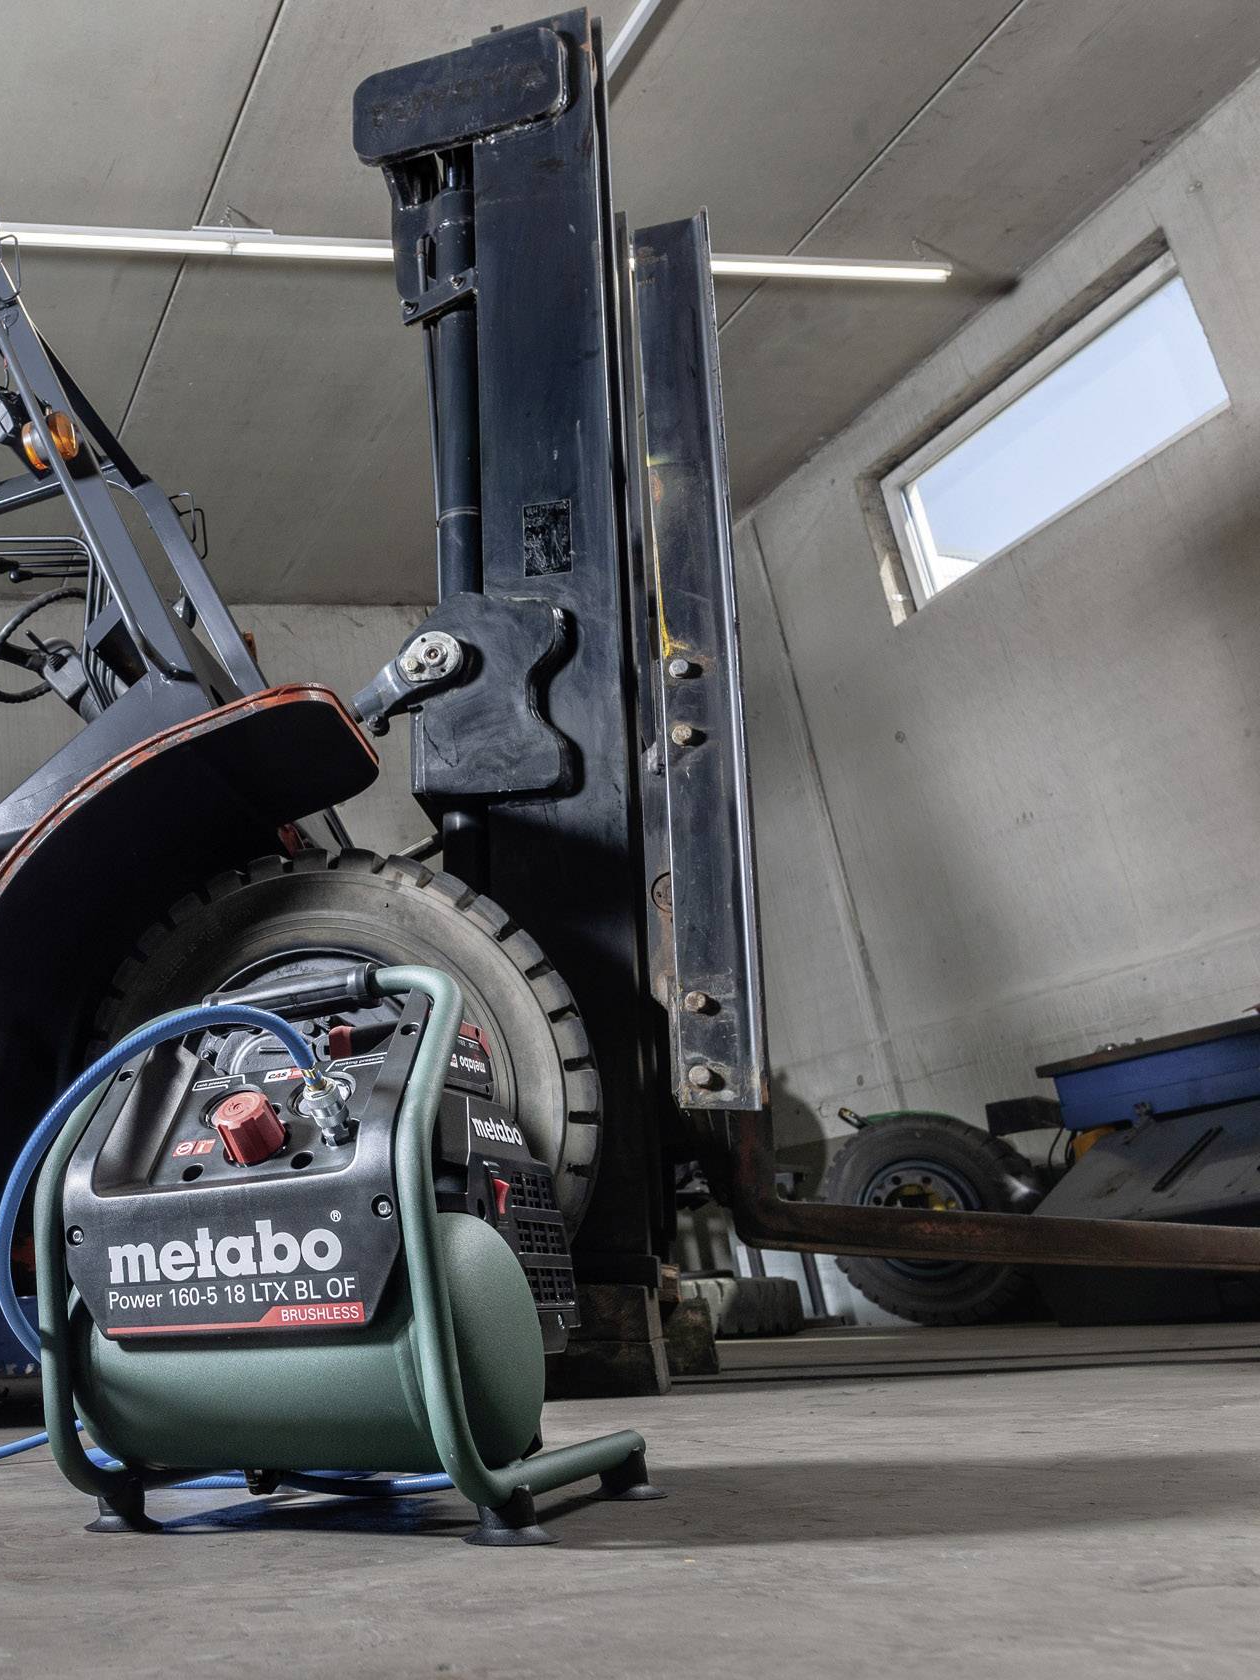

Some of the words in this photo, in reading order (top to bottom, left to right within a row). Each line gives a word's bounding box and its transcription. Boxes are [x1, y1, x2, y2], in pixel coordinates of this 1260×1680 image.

[459, 1055, 486, 1073] metabo
[471, 1117, 523, 1146] metabo
[108, 1219, 342, 1284] metabo
[108, 1290, 163, 1310] Power
[169, 1286, 218, 1307] 160-5
[225, 1284, 245, 1303] 18
[252, 1281, 289, 1302] LTX
[295, 1279, 321, 1299] BL
[326, 1277, 356, 1299] OF
[281, 1306, 359, 1321] BRUSHLESS
